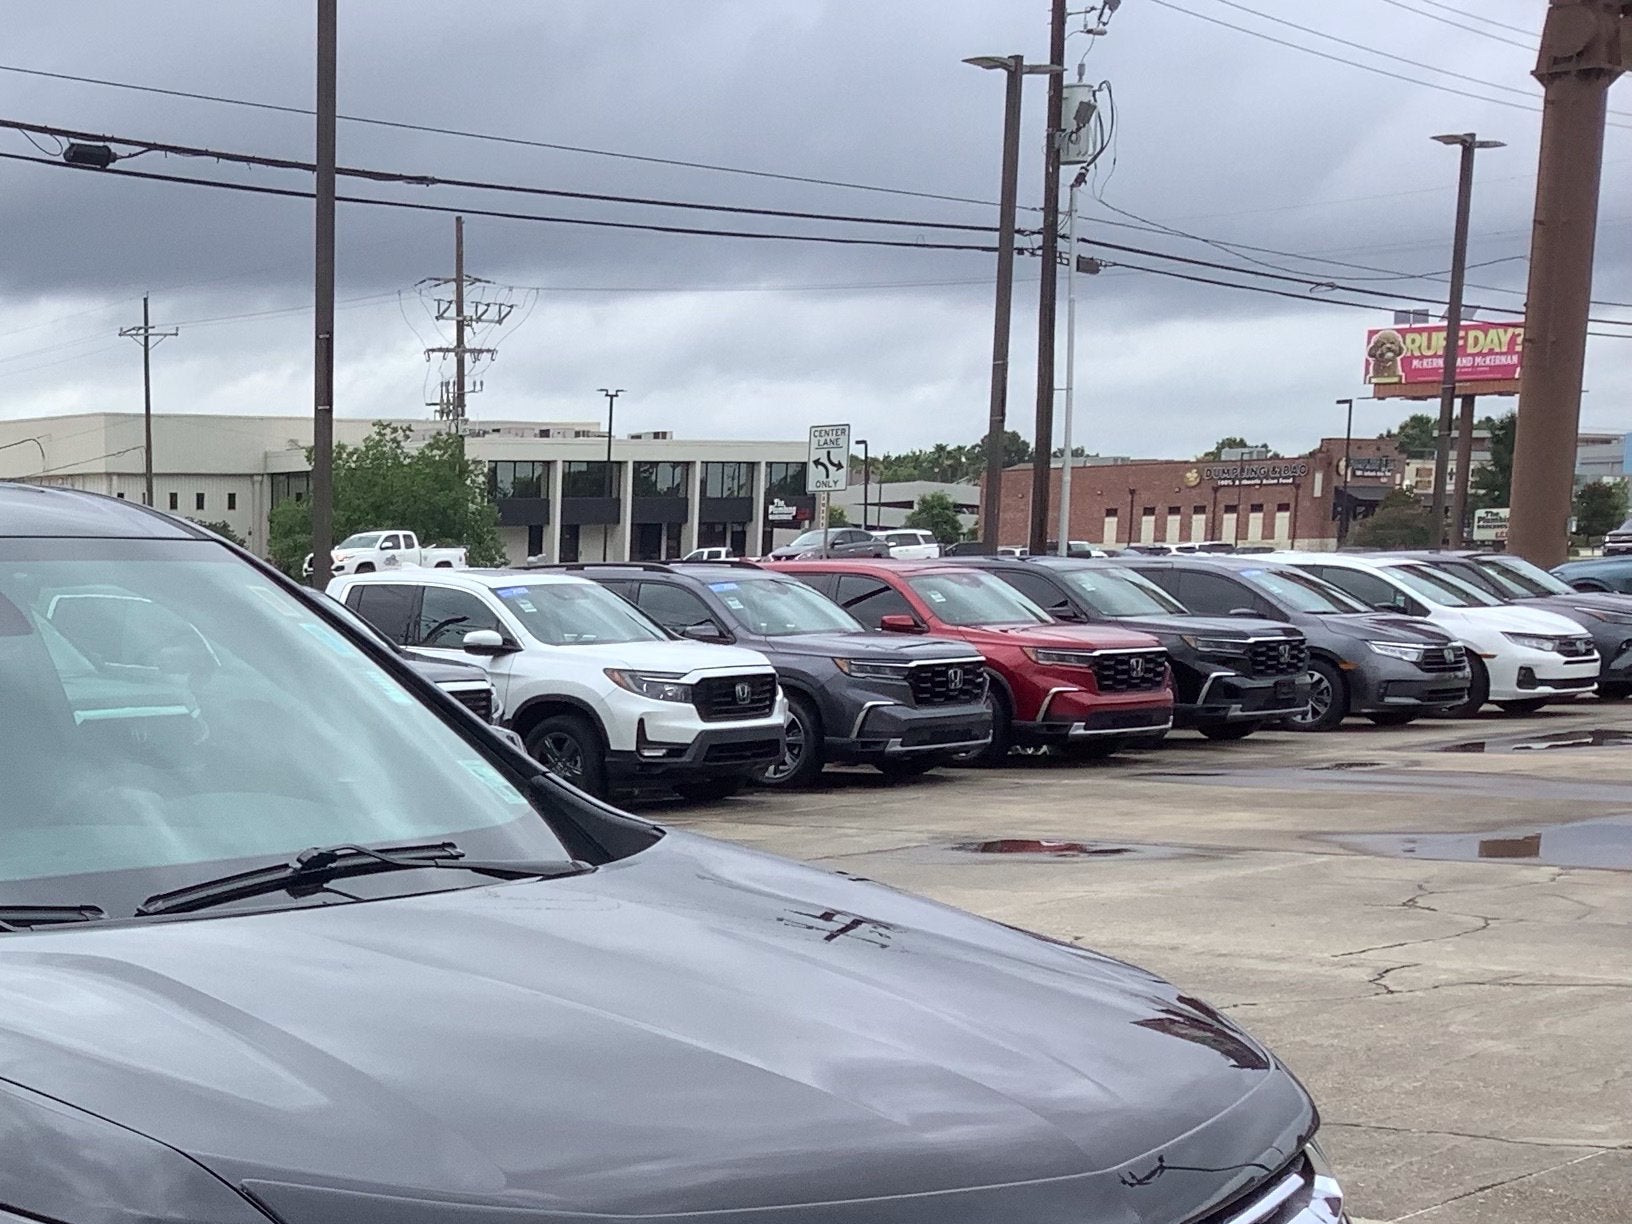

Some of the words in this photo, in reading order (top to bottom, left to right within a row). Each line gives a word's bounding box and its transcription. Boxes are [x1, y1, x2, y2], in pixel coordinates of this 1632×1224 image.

[1467, 327, 1524, 353] DAY?
[813, 428, 847, 438] CENTER
[817, 438, 841, 447] LANE
[1269, 465, 1281, 477] &
[1282, 463, 1308, 476] BAO
[815, 480, 839, 488] ONLY
